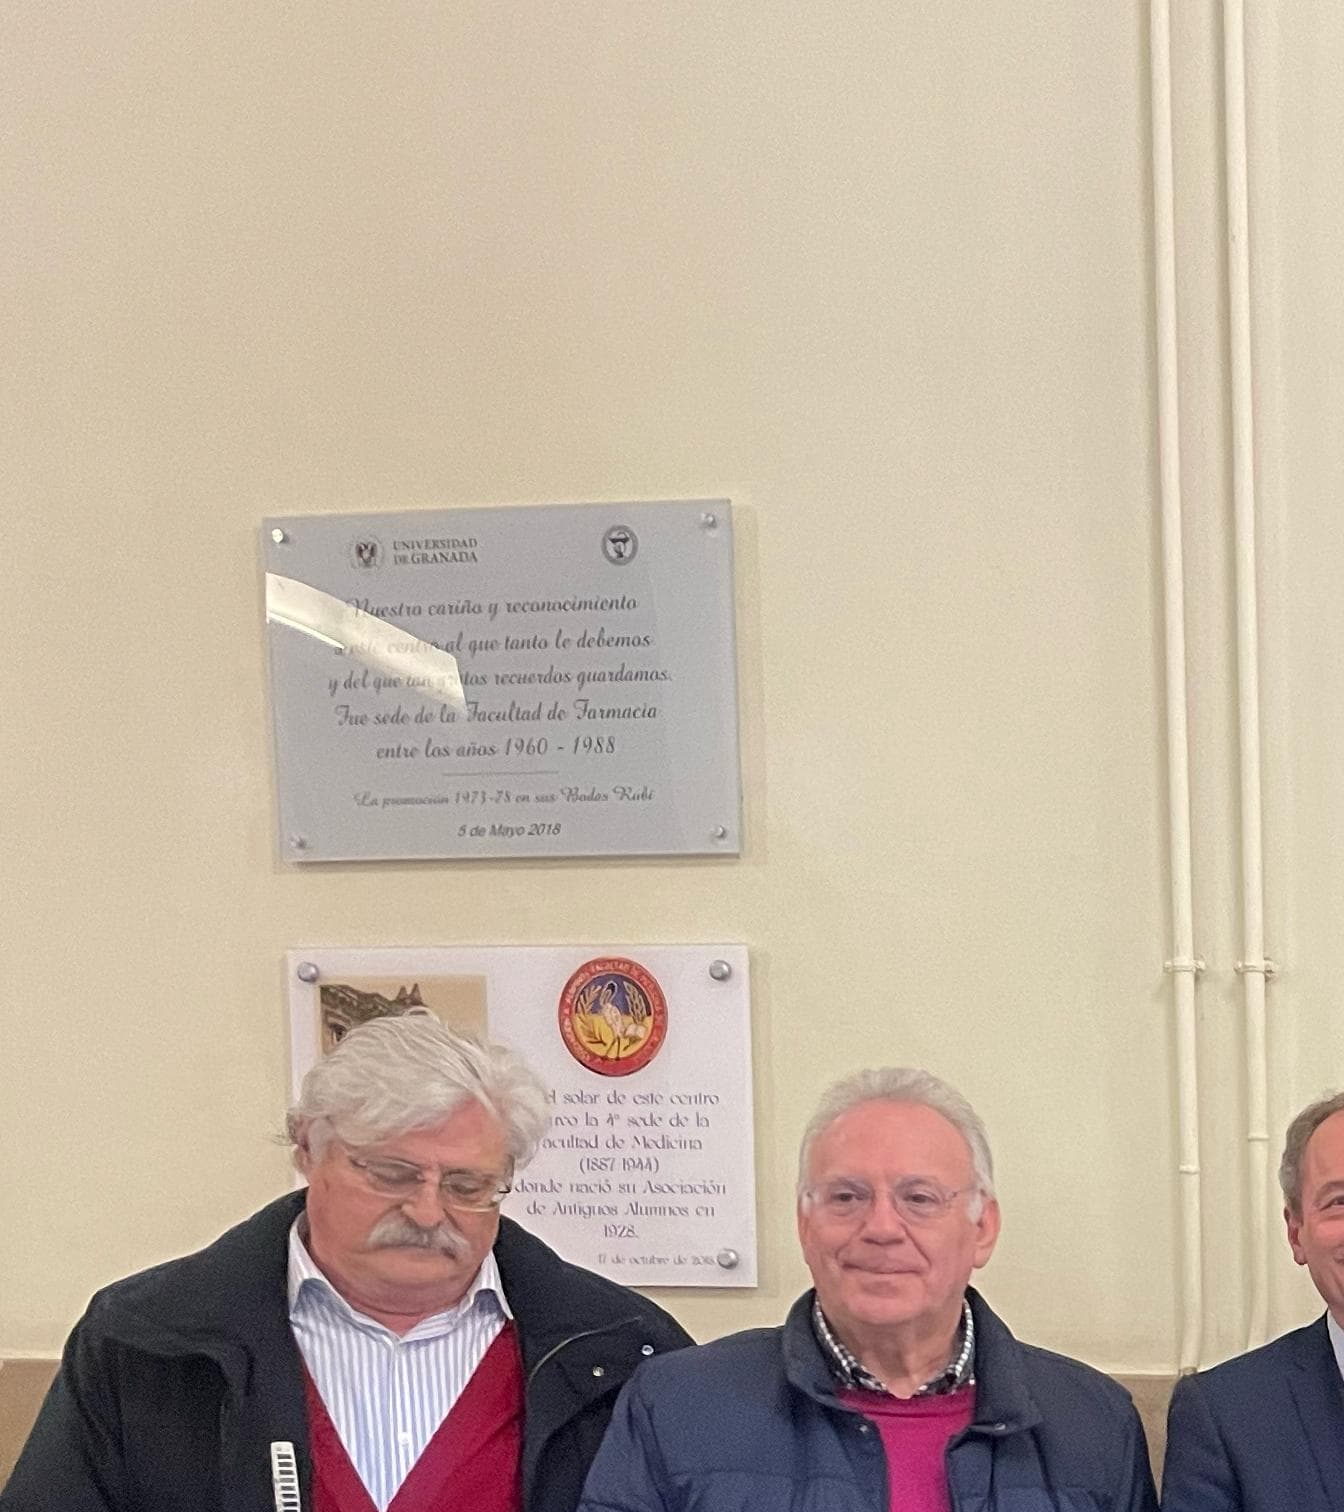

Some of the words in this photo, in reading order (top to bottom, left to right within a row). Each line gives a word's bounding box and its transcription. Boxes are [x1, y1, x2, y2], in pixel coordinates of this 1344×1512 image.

[393, 538, 478, 550] UNIVERSIDAD
[411, 552, 478, 564] GRANADA
[428, 599, 482, 617] cariño
[489, 602, 498, 620] y
[507, 595, 637, 613] reconocimiento
[446, 632, 463, 651] al
[468, 641, 498, 658] que
[505, 635, 547, 650] tanto
[556, 629, 570, 649] le
[577, 627, 650, 648] debemos
[329, 679, 338, 696] y
[344, 670, 368, 689] del
[373, 677, 400, 692] que
[495, 665, 571, 685] recuerdos
[335, 705, 368, 726] Fue
[374, 705, 409, 725] sede
[415, 706, 433, 724] de
[440, 704, 456, 723] la
[467, 701, 541, 722] Facultad
[548, 702, 565, 720] de
[574, 699, 657, 720] Farmacia
[376, 744, 418, 758] entre
[425, 738, 450, 758] los
[456, 742, 496, 756] años
[505, 737, 548, 756] 1960
[573, 736, 616, 754] 1988
[470, 825, 485, 836] de
[489, 825, 525, 838] Mayo
[528, 823, 561, 835] 2018
[564, 1091, 599, 1104] solar
[607, 1090, 625, 1104] de
[633, 1093, 660, 1104] este
[670, 1093, 719, 1105] centro
[586, 1112, 598, 1127] la
[628, 1113, 662, 1127] sede
[669, 1112, 688, 1127] de
[697, 1112, 709, 1127] la
[542, 1135, 598, 1149] acultad
[606, 1134, 624, 1149] de
[632, 1135, 702, 1149] Medicina
[515, 1180, 562, 1194] donde
[570, 1179, 611, 1194] nació
[619, 1183, 635, 1194] su
[643, 1180, 726, 1195] Asociación
[527, 1202, 546, 1215] de
[553, 1203, 618, 1218] Antiguos
[625, 1202, 688, 1217] Alumnos
[696, 1207, 714, 1217] en
